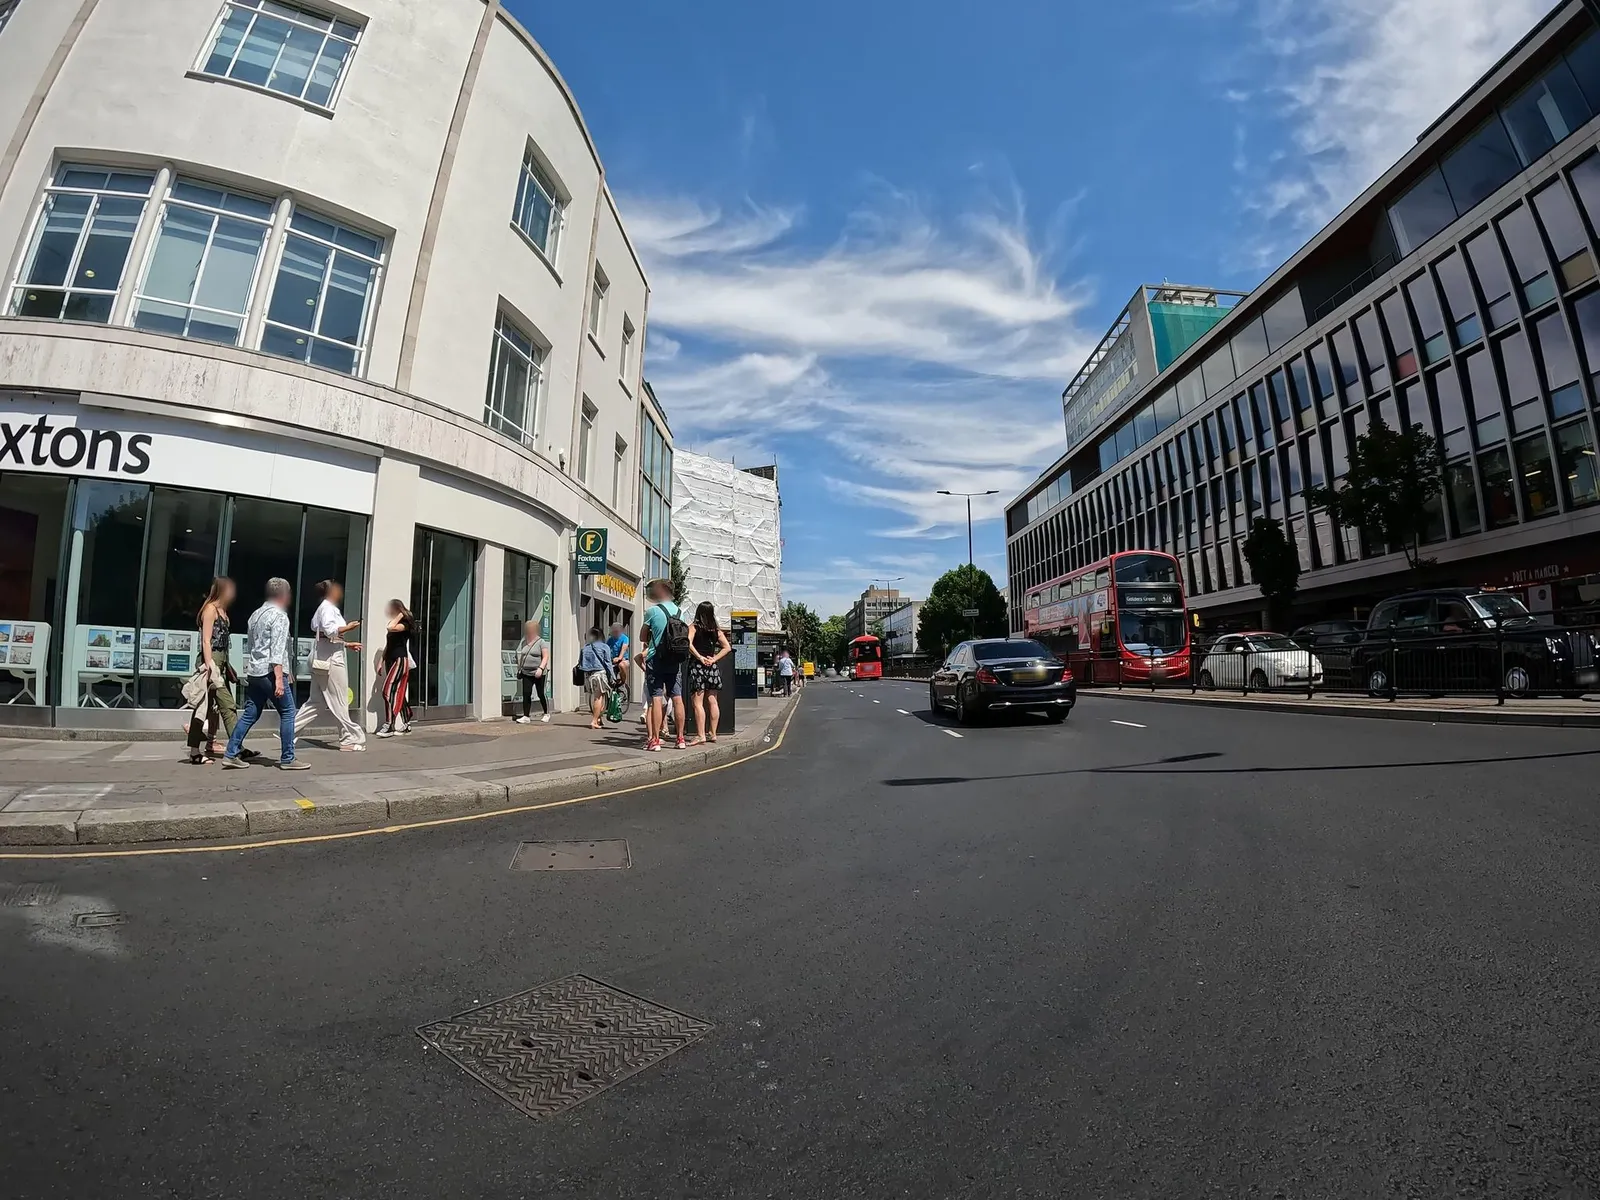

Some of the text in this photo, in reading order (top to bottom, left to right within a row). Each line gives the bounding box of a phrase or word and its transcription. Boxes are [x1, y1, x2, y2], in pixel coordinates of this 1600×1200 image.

[0, 414, 153, 474] xtons
[585, 534, 596, 551] F
[577, 554, 603, 562] Foxtons
